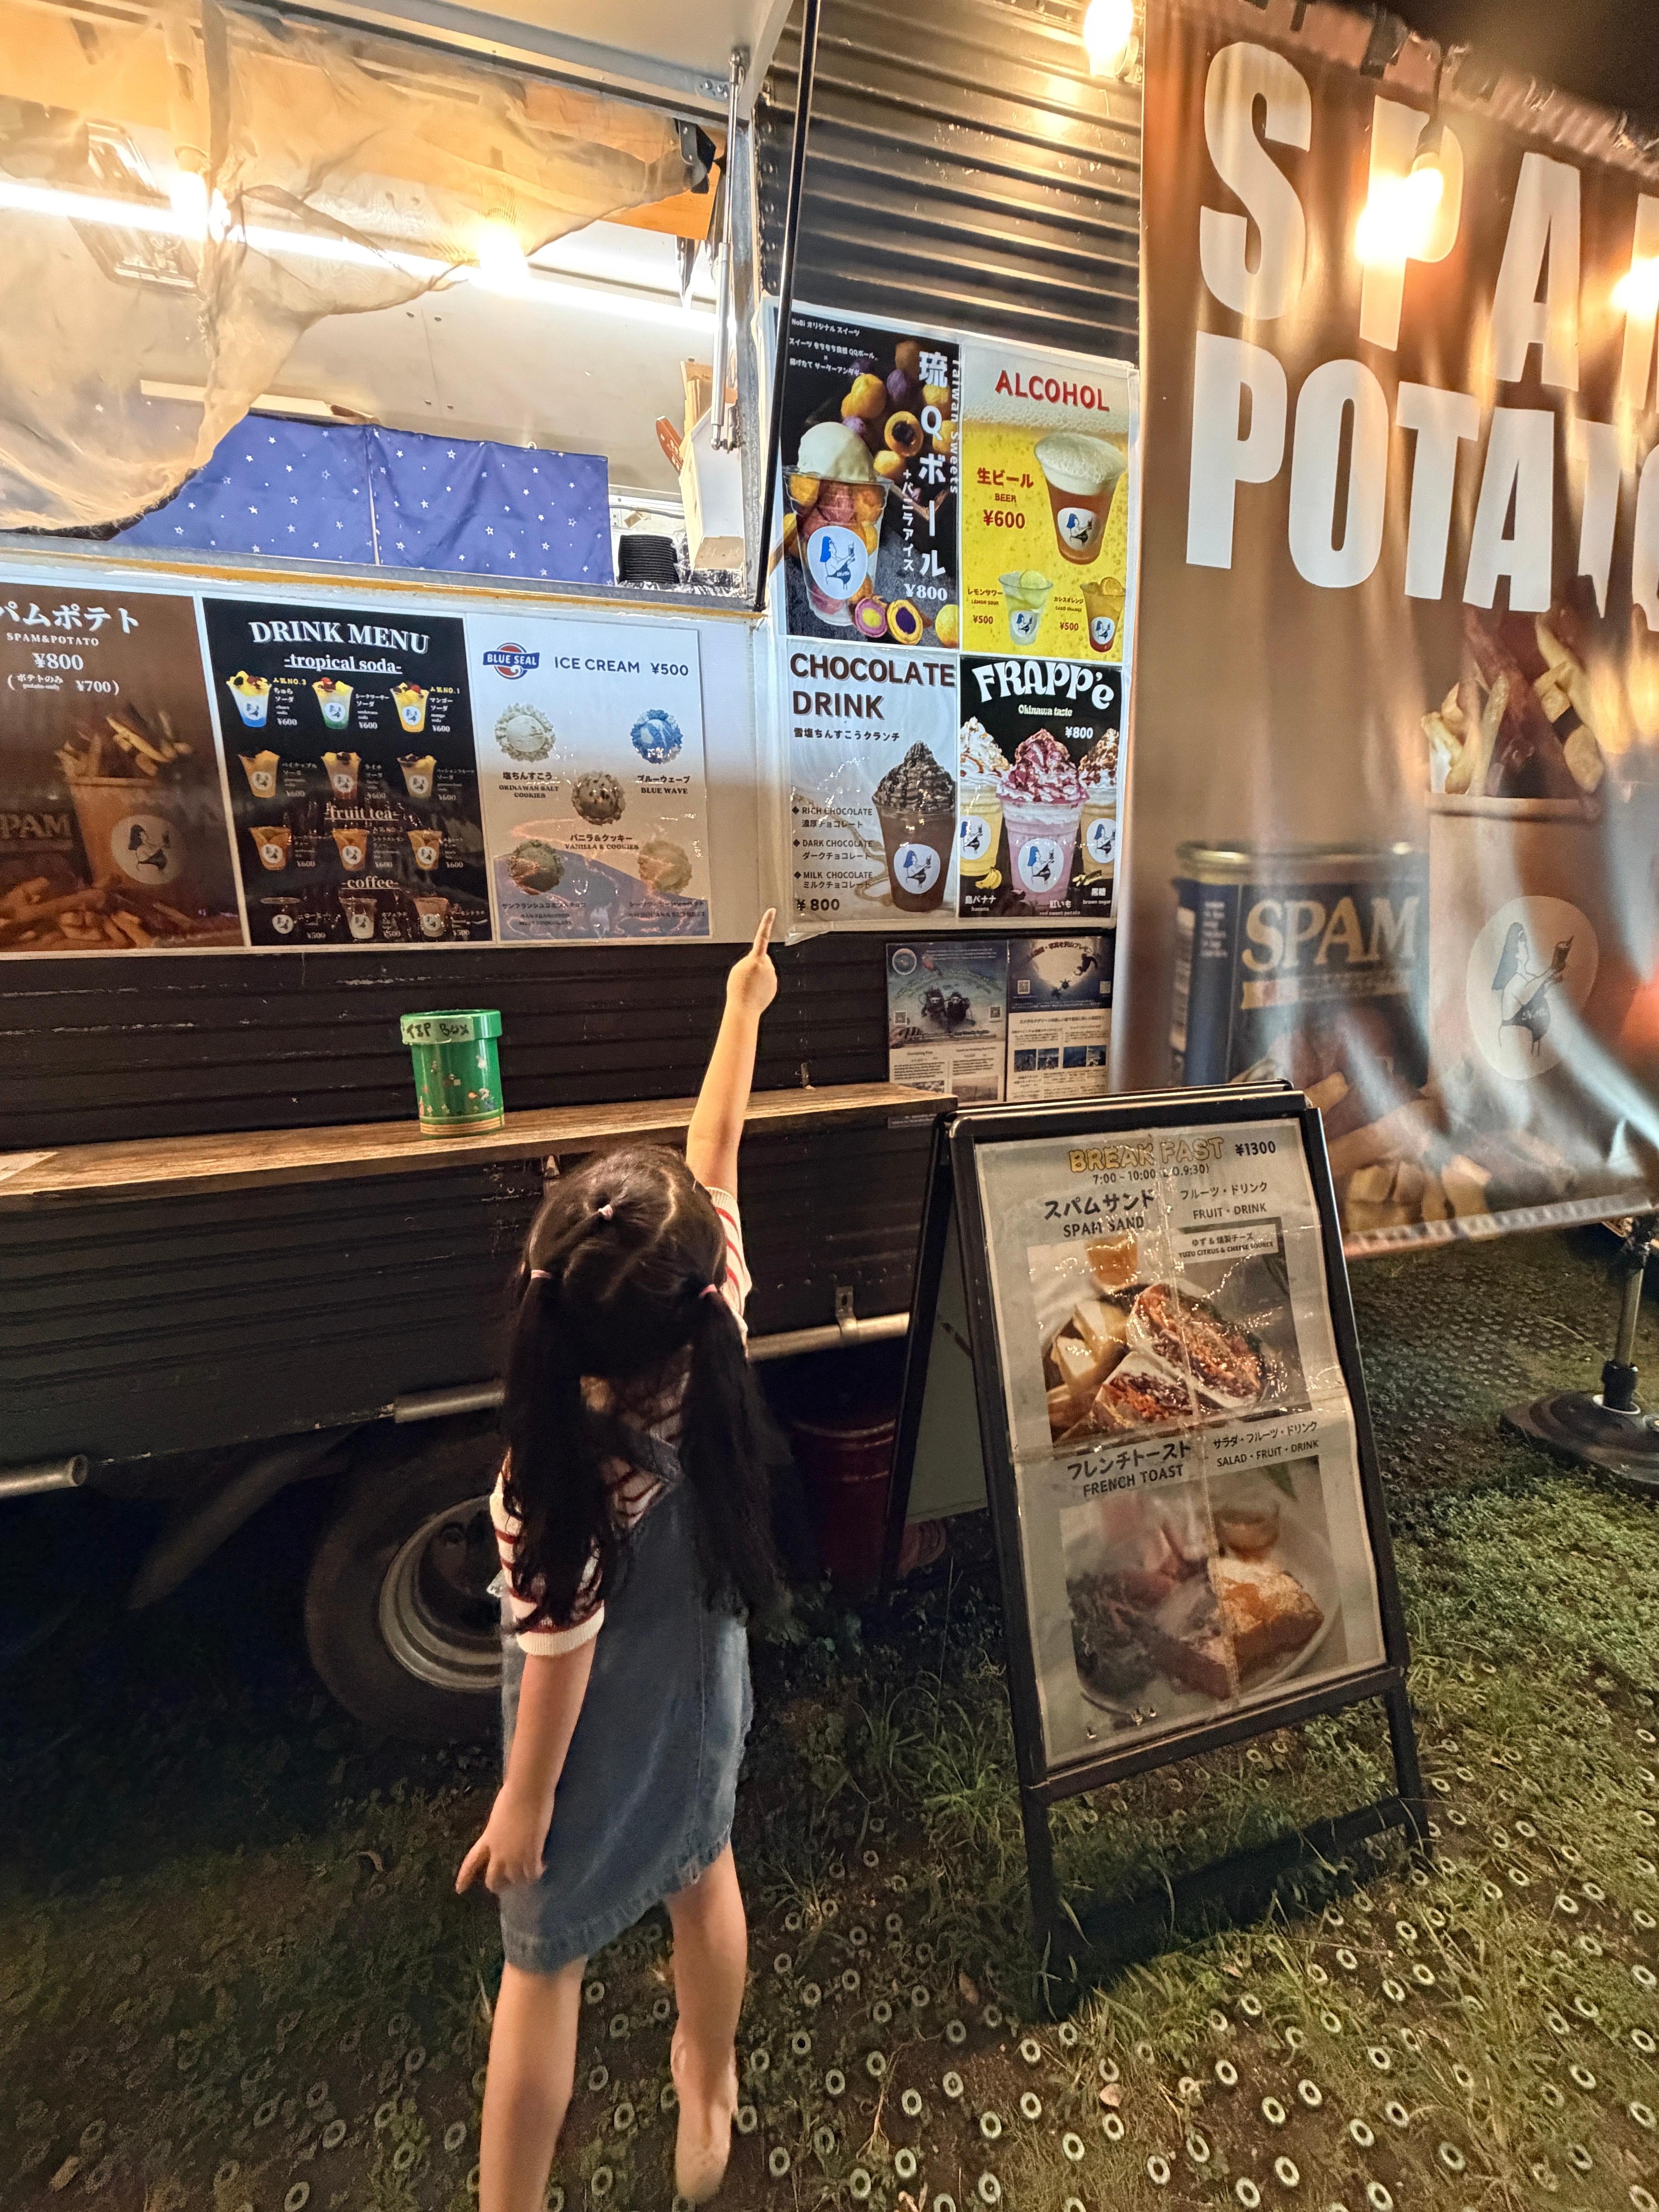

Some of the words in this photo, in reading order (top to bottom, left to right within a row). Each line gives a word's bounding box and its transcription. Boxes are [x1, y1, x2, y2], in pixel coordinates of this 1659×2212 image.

[807, 321, 835, 332] オリジナル
[837, 326, 860, 337] スイーツ
[789, 338, 812, 348] スイーツ
[995, 370, 1110, 412] ALCOHOL
[950, 430, 959, 494] Sweets
[977, 467, 1034, 489] 生ビール
[1186, 329, 1659, 632] POTAT
[994, 493, 1016, 503] BEER
[983, 510, 1025, 529] ¥600
[903, 583, 948, 601] ¥800
[968, 588, 1003, 596] レモンサワー
[973, 615, 993, 624] ¥500
[1060, 622, 1079, 631] ¥500
[7, 633, 99, 646] SPAM&POTATO
[248, 620, 343, 644] DRINK
[348, 623, 430, 654] MENU
[33, 653, 84, 670] ¥800
[487, 653, 512, 664] BLUE
[514, 655, 537, 666] SEAL
[555, 656, 580, 670] ICE
[585, 658, 640, 673] CREAM
[651, 663, 689, 676] ¥500
[790, 653, 955, 687] CHOCOLATE
[793, 690, 884, 720] DRINK
[1018, 704, 1053, 716] Okinawa
[1054, 707, 1073, 717] taste
[1065, 726, 1093, 739] ¥800
[503, 771, 552, 780] 塩ちんすこう
[637, 775, 690, 784] ブルーウェーブ
[824, 807, 872, 816] CHOCOLATE
[570, 834, 633, 842] バニラ&クッキー
[802, 852, 871, 860] ダークチョコレート
[965, 895, 996, 904] 島バナナ
[1242, 897, 1419, 972] SPAM
[1069, 1142, 1154, 1172] BREAK
[1161, 1137, 1224, 1163] FAST
[1236, 1141, 1276, 1156] ¥1300
[1093, 1173, 1116, 1185] 7:00
[1128, 1168, 1156, 1181] 10:00
[1044, 1192, 1154, 1220] スパムサンド
[1063, 1221, 1103, 1238] SPAM
[1108, 1216, 1144, 1232] SAND
[1197, 1248, 1219, 1256] CITRUS
[1067, 1440, 1191, 1480] フレンチトースト
[1083, 1474, 1135, 1497] FRENCH
[1139, 1463, 1183, 1483] TOAST
